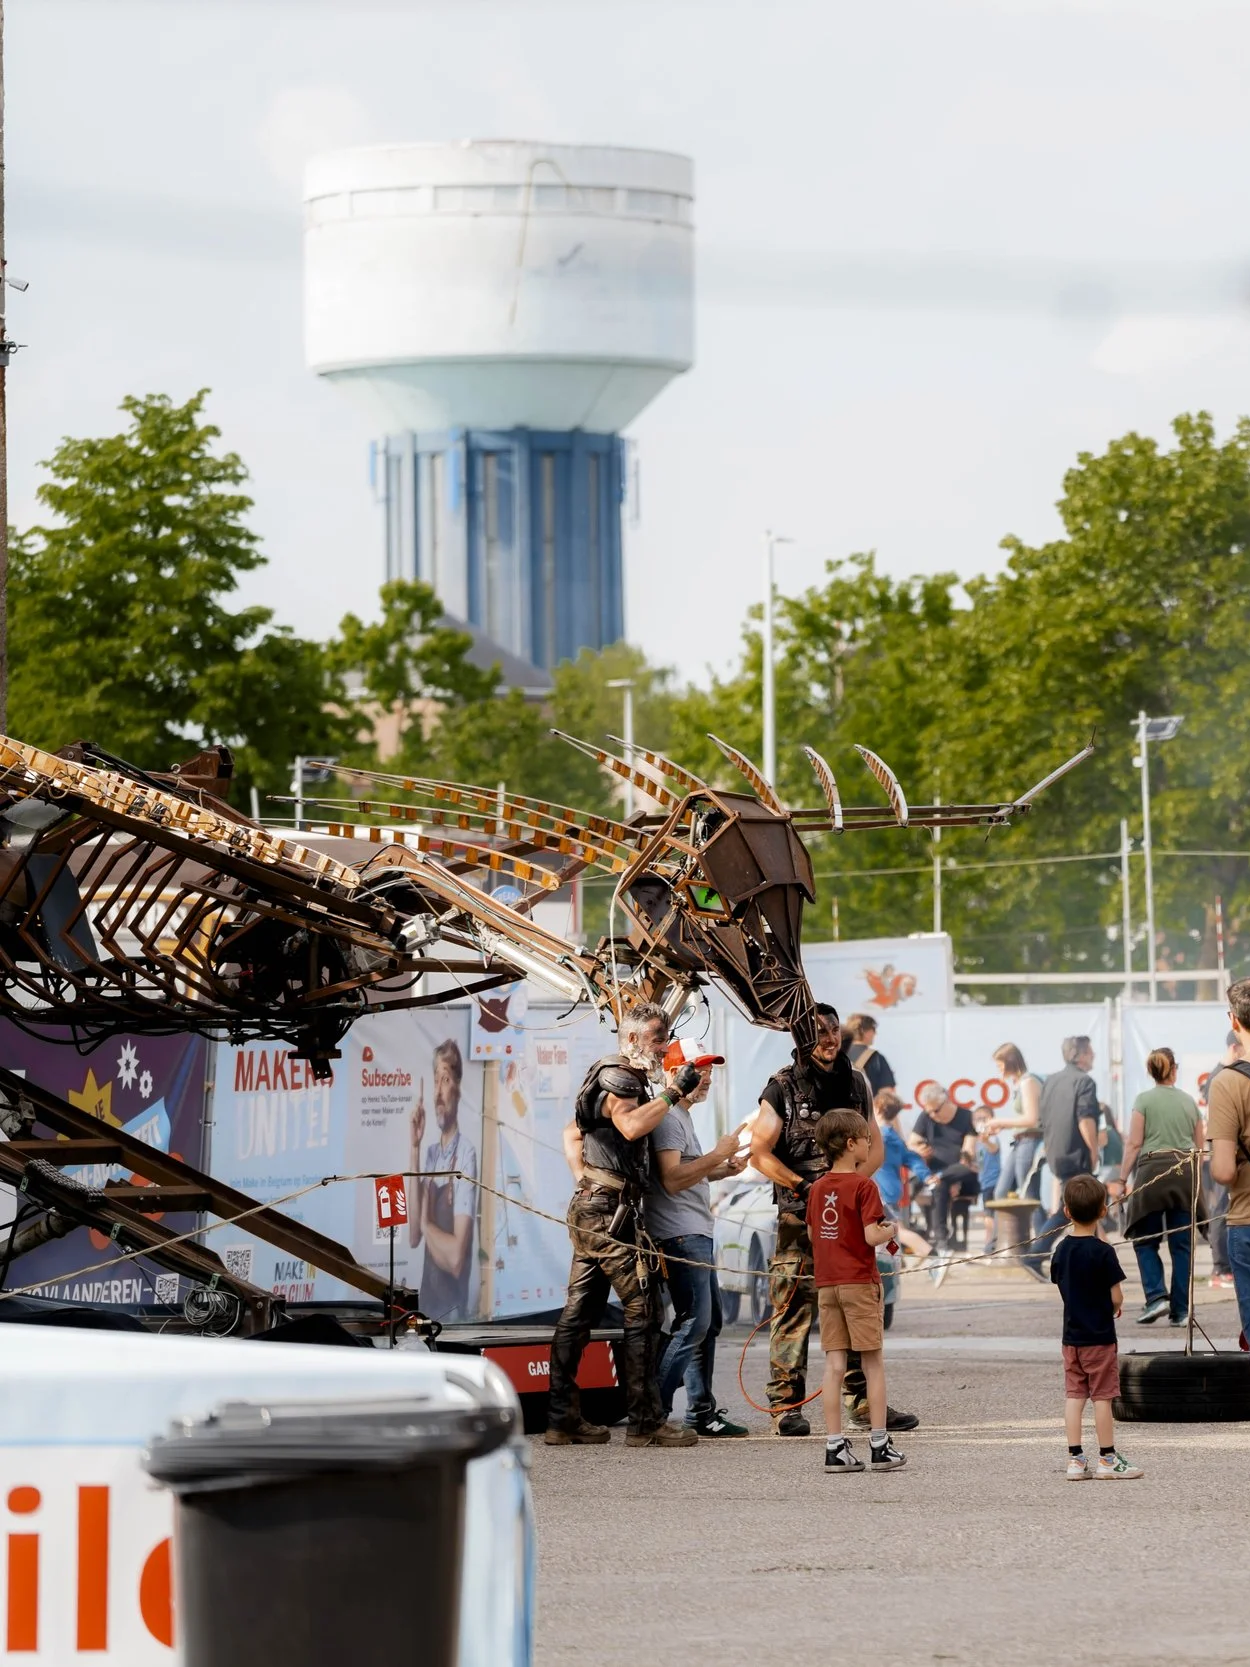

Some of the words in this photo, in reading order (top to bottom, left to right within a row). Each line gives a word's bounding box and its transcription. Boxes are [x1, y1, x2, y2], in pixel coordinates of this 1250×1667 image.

[362, 1068, 411, 1087] Subscribe
[274, 1260, 305, 1281] MAKE
[527, 1361, 550, 1376] GAR
